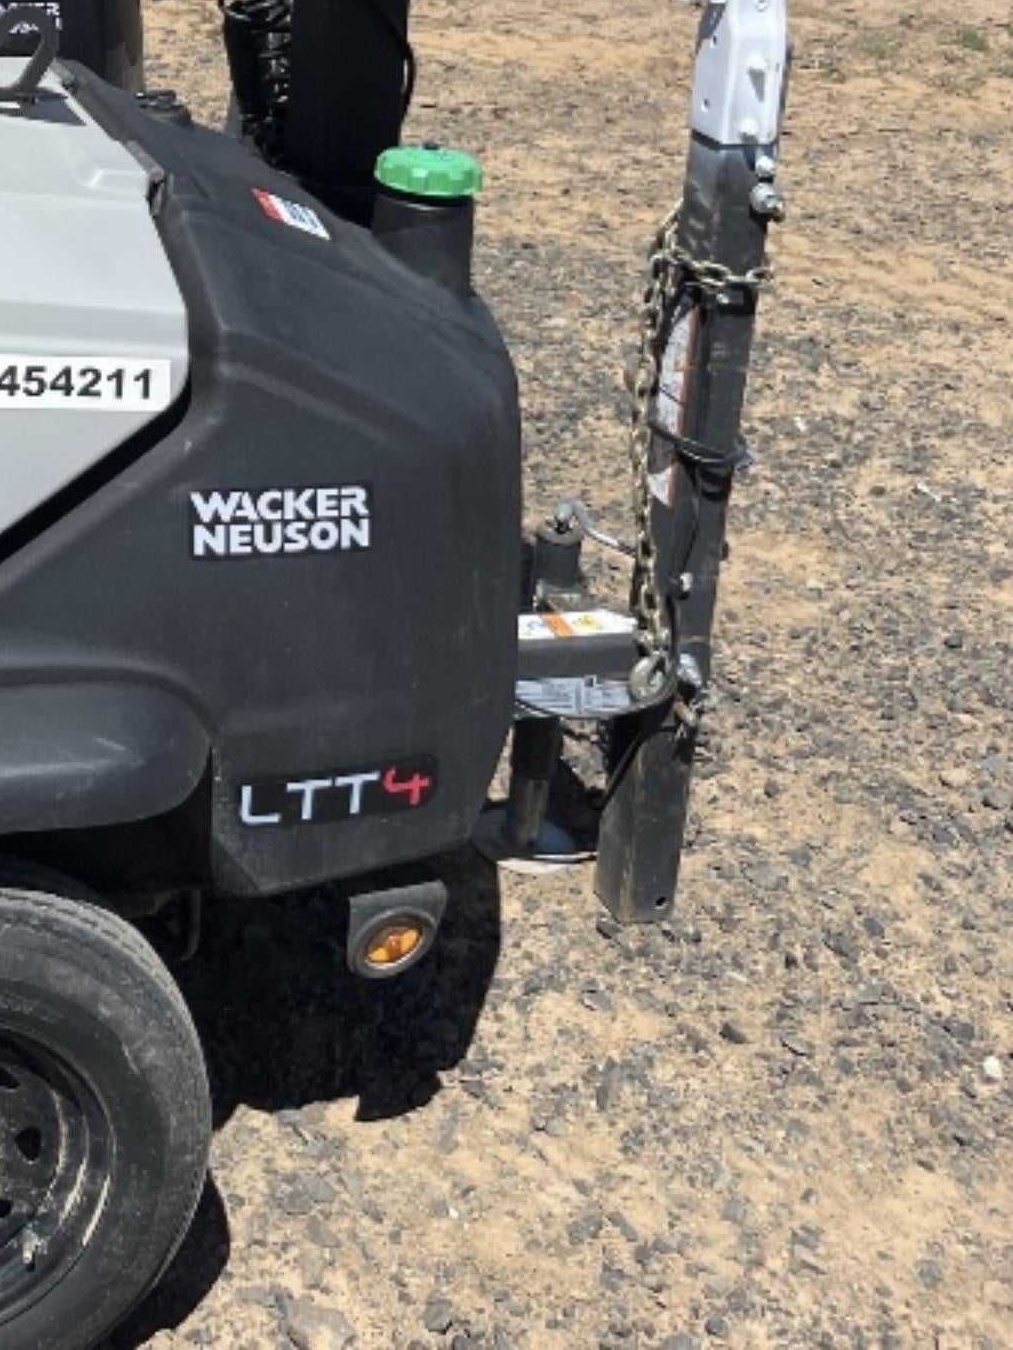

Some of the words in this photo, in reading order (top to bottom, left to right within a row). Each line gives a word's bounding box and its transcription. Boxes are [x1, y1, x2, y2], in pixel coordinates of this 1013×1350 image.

[190, 484, 370, 523] WACKER
[192, 517, 370, 557] NEUSON
[240, 764, 431, 826] LTT4
